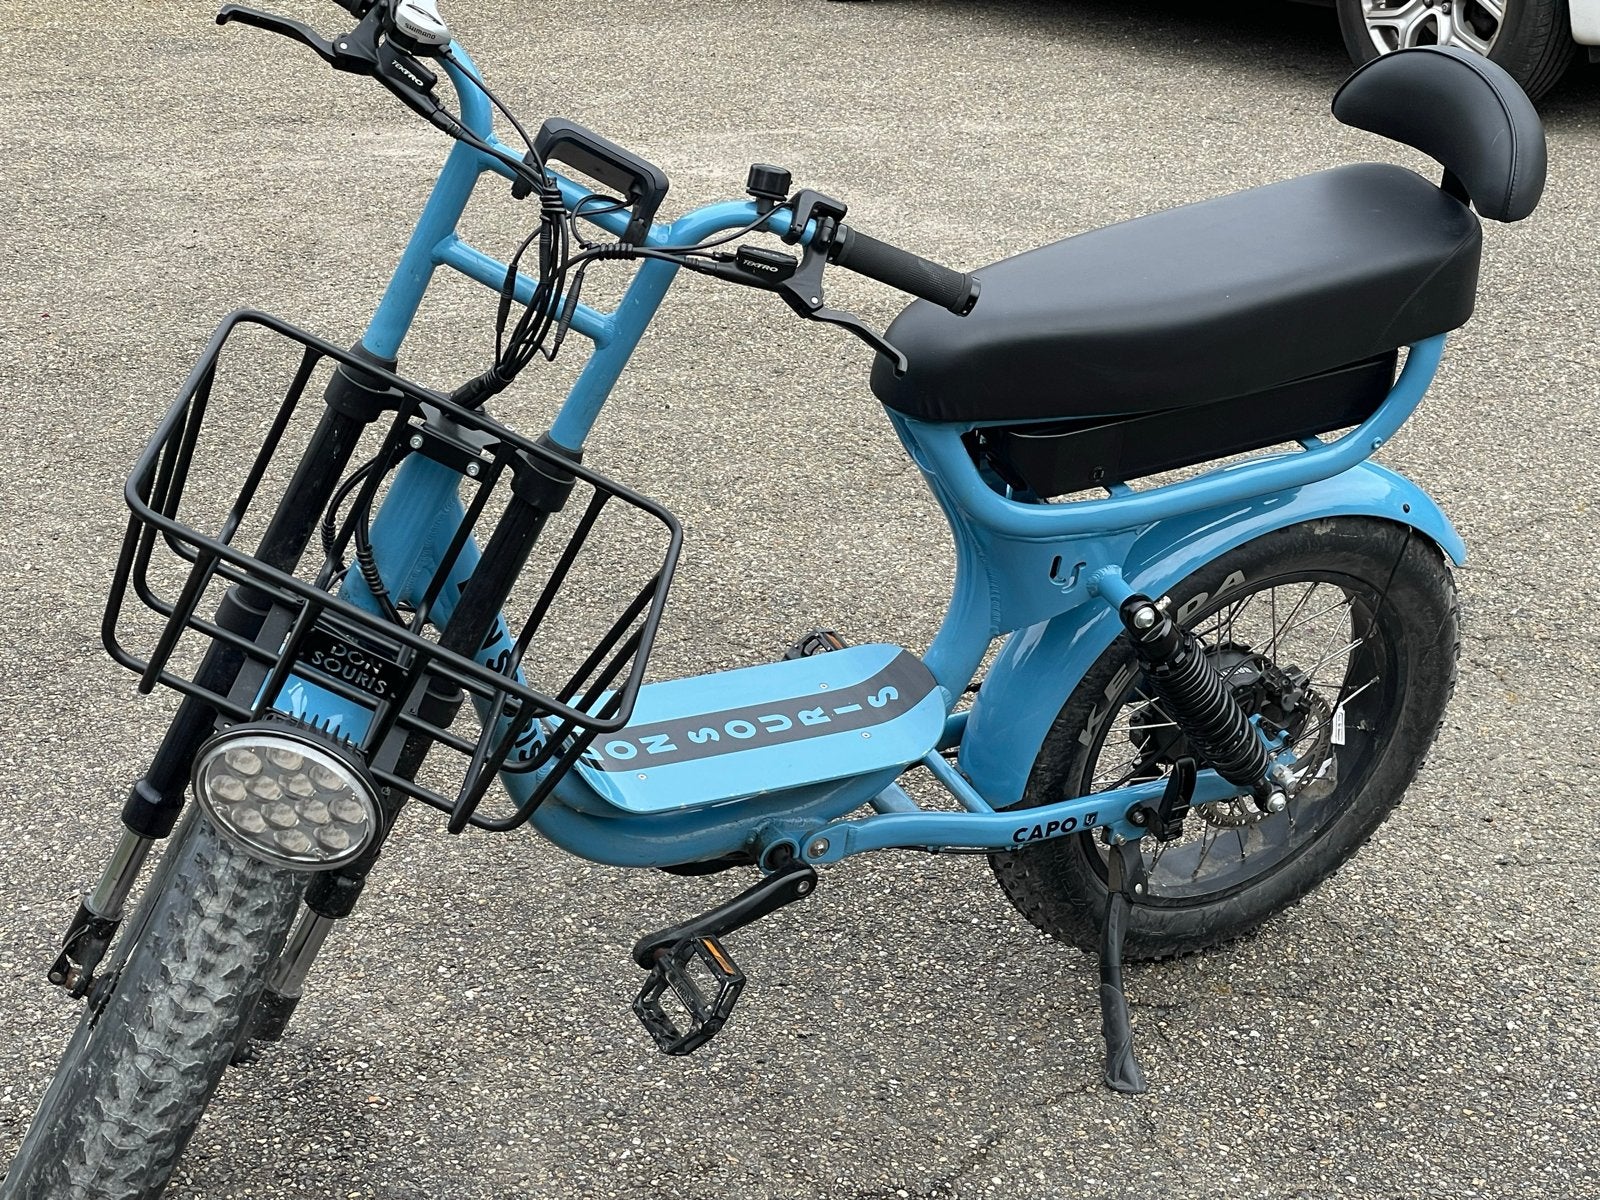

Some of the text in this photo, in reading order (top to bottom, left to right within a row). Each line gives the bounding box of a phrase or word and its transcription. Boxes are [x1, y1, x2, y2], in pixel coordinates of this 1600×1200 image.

[404, 23, 436, 40] SHIMANO
[391, 60, 424, 87] TEKTRO
[742, 259, 779, 273] TEKTRO
[311, 650, 388, 694] SOURIS
[330, 643, 383, 675] DON
[687, 685, 899, 744] SOURIS
[1012, 816, 1078, 843] CAPO
